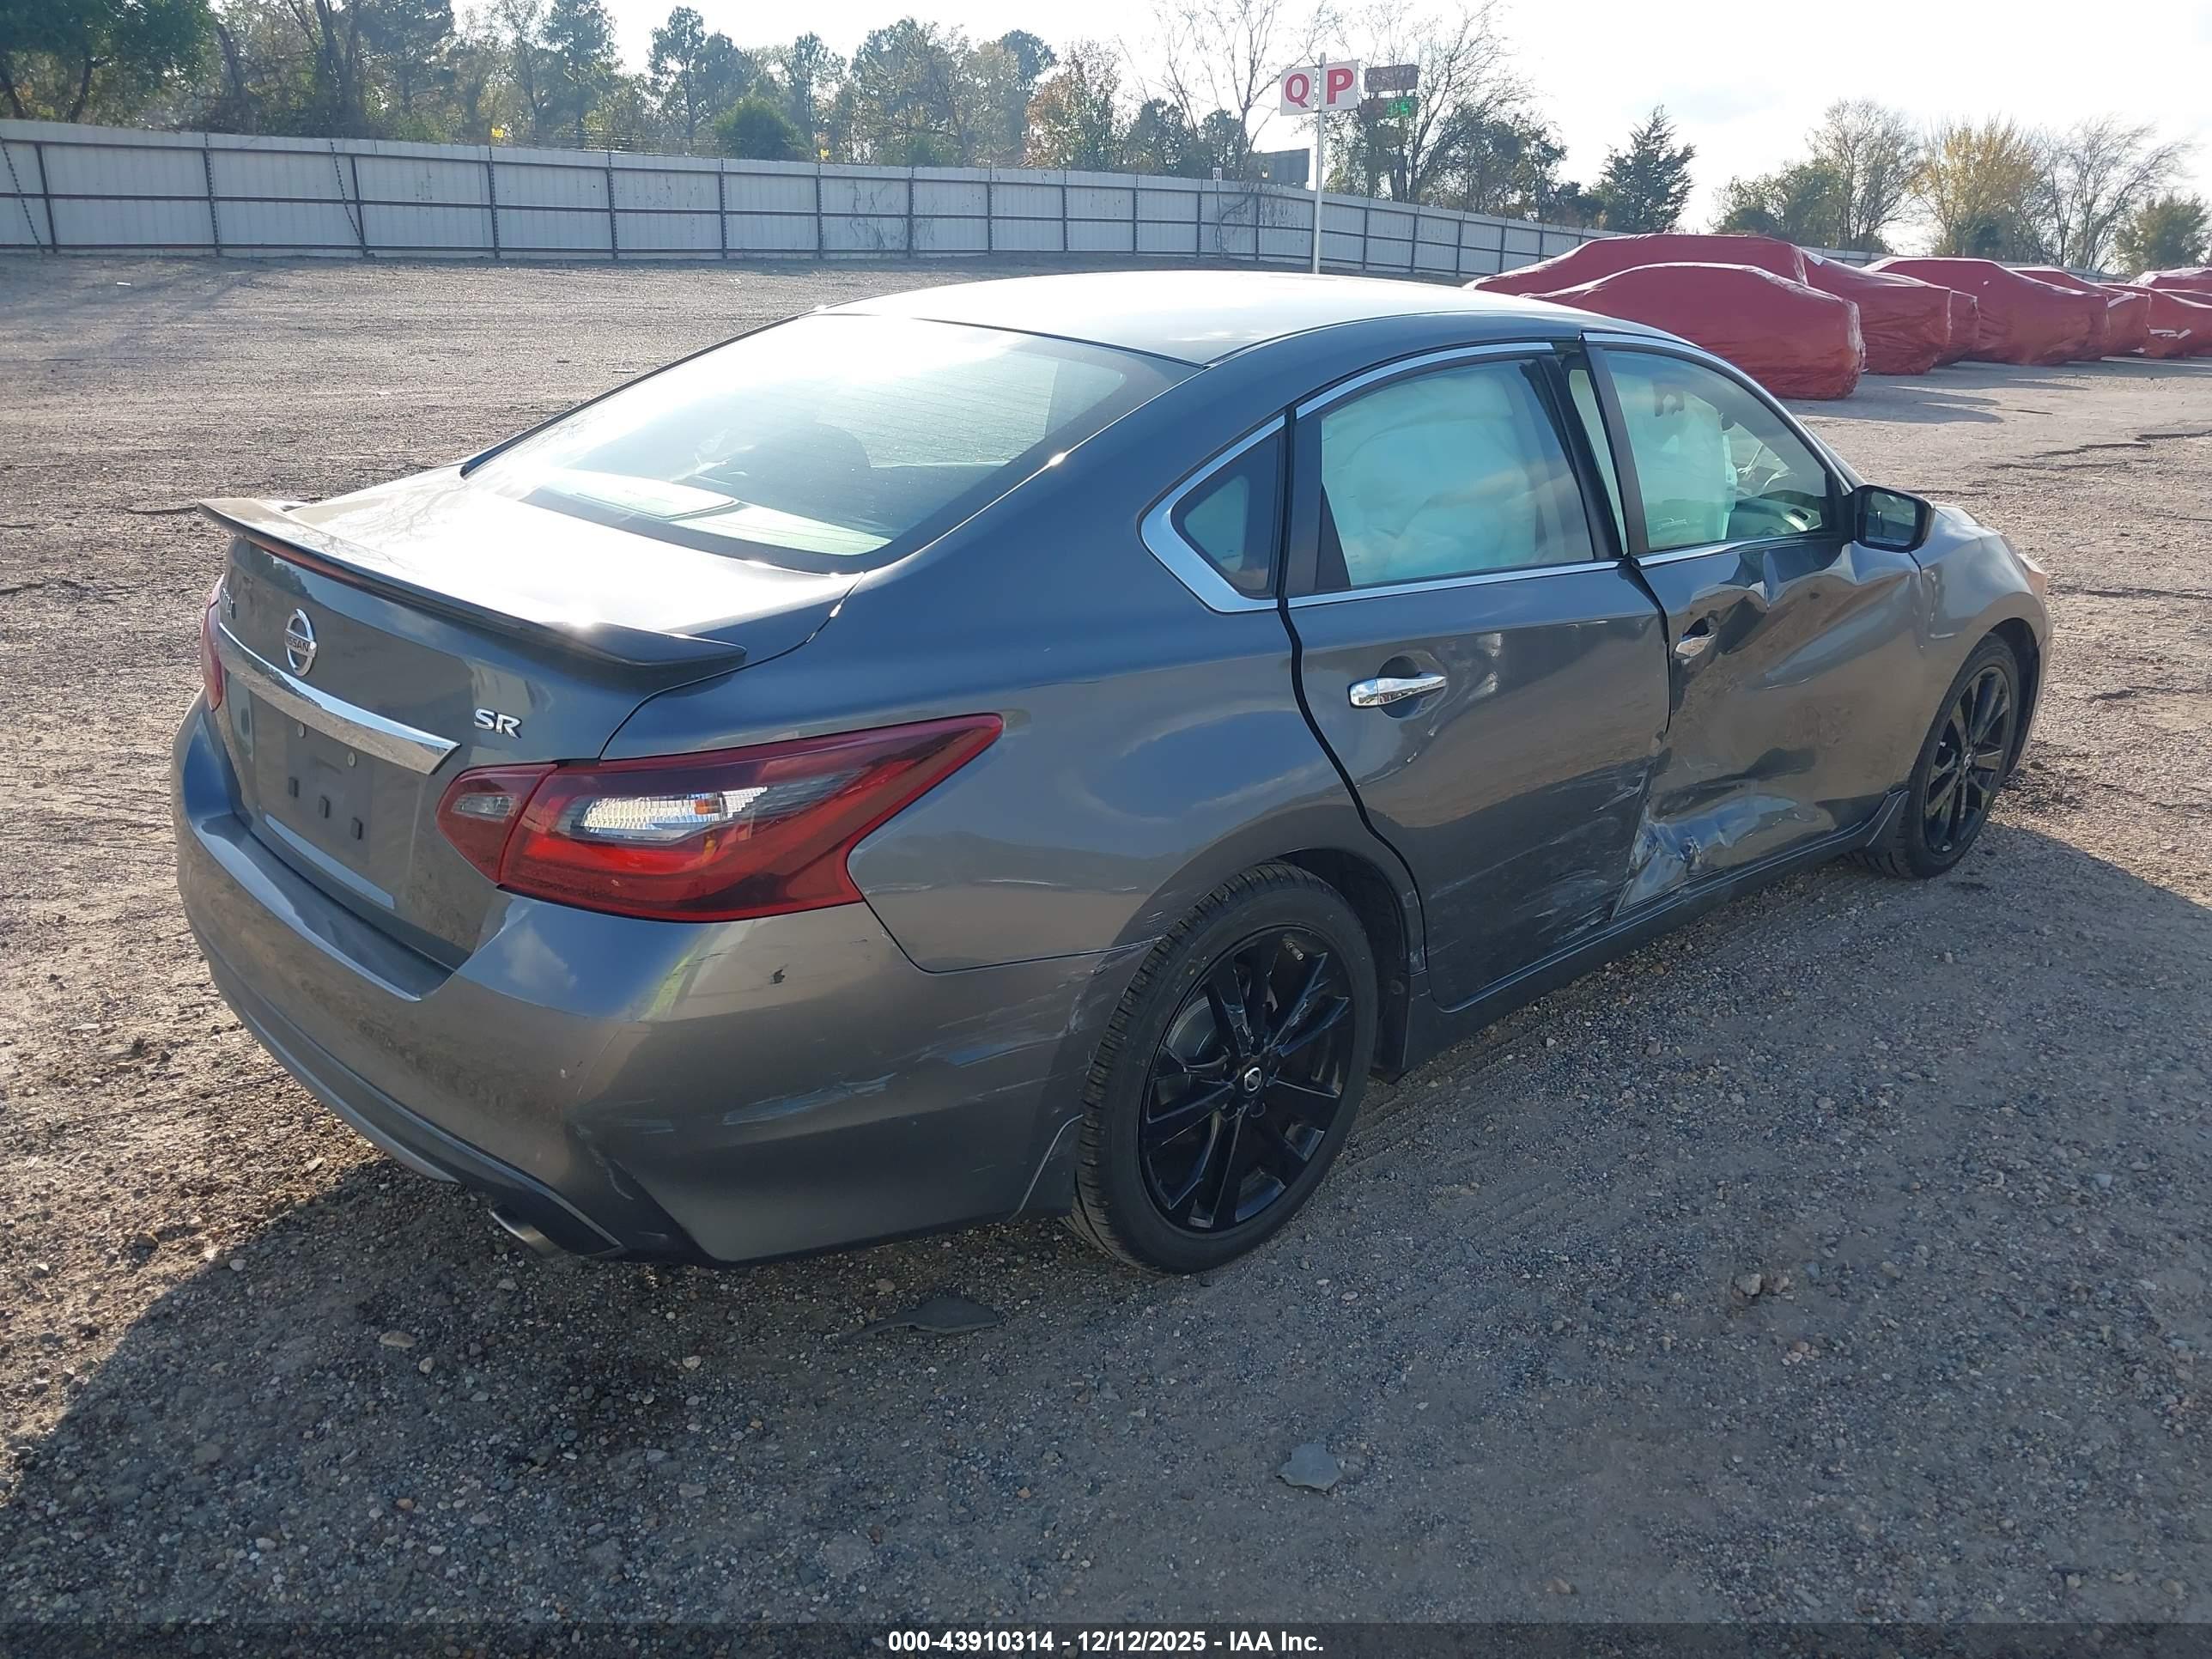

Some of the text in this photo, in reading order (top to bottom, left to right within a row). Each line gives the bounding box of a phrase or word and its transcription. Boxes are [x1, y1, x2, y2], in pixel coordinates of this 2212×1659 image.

[1285, 73, 1310, 108] Q
[1327, 69, 1354, 105] P
[287, 635, 309, 653] SSAN
[474, 708, 521, 738] SR
